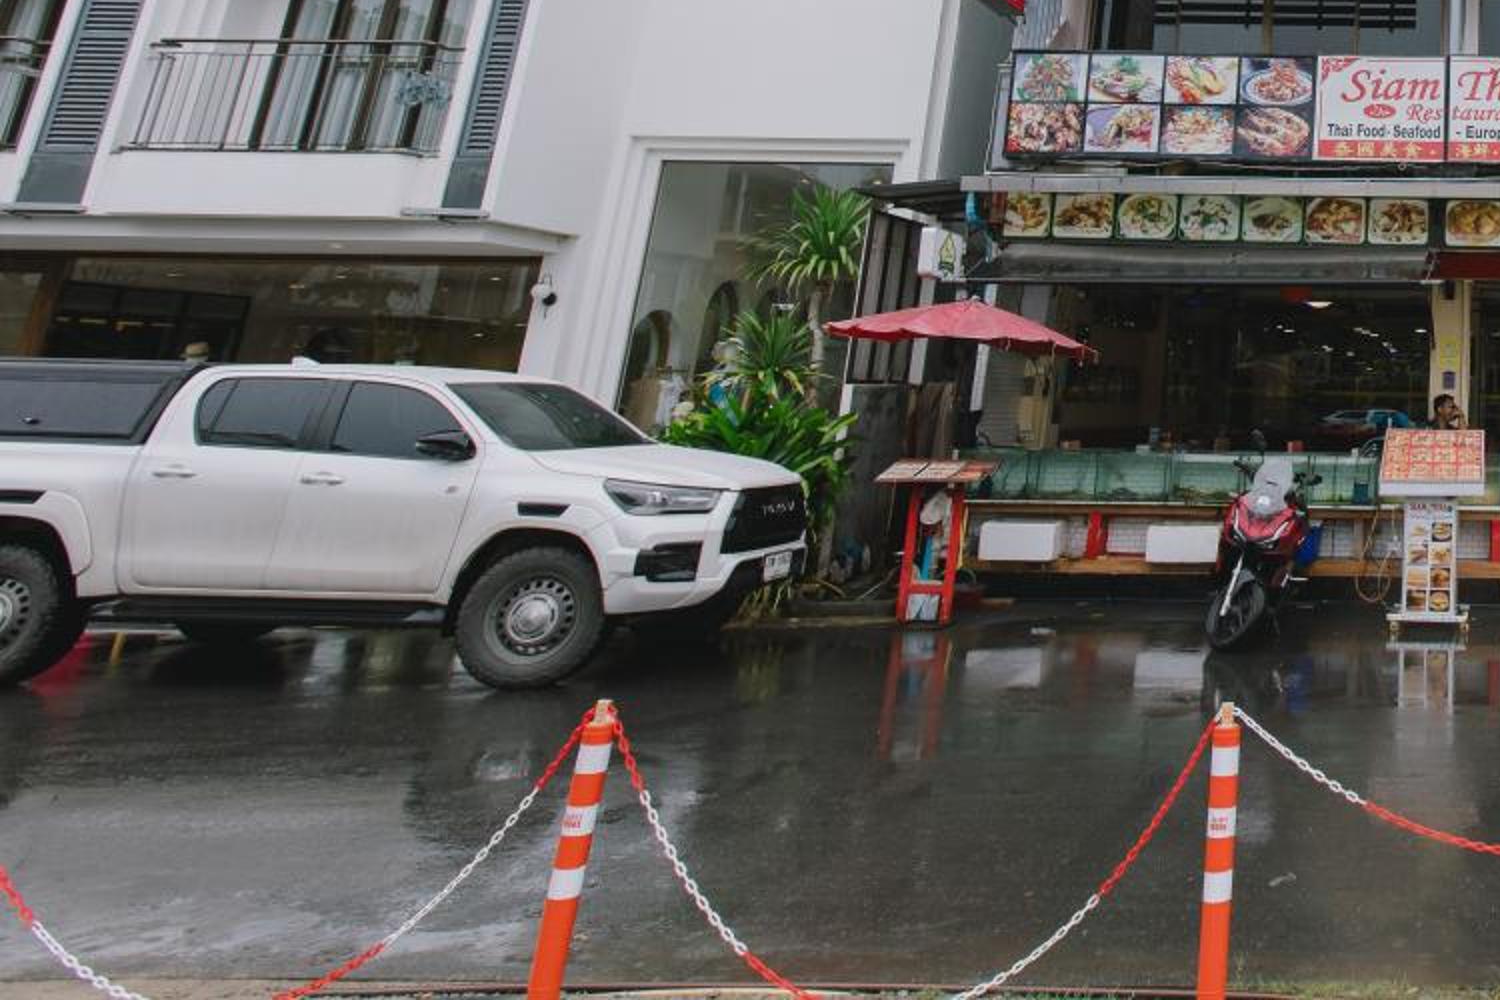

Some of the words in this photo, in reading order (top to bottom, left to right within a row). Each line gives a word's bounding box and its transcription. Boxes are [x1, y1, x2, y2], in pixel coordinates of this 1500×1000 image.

[1341, 69, 1441, 103] Siam
[1327, 123, 1353, 137] Thai
[1393, 125, 1441, 139] Seafood
